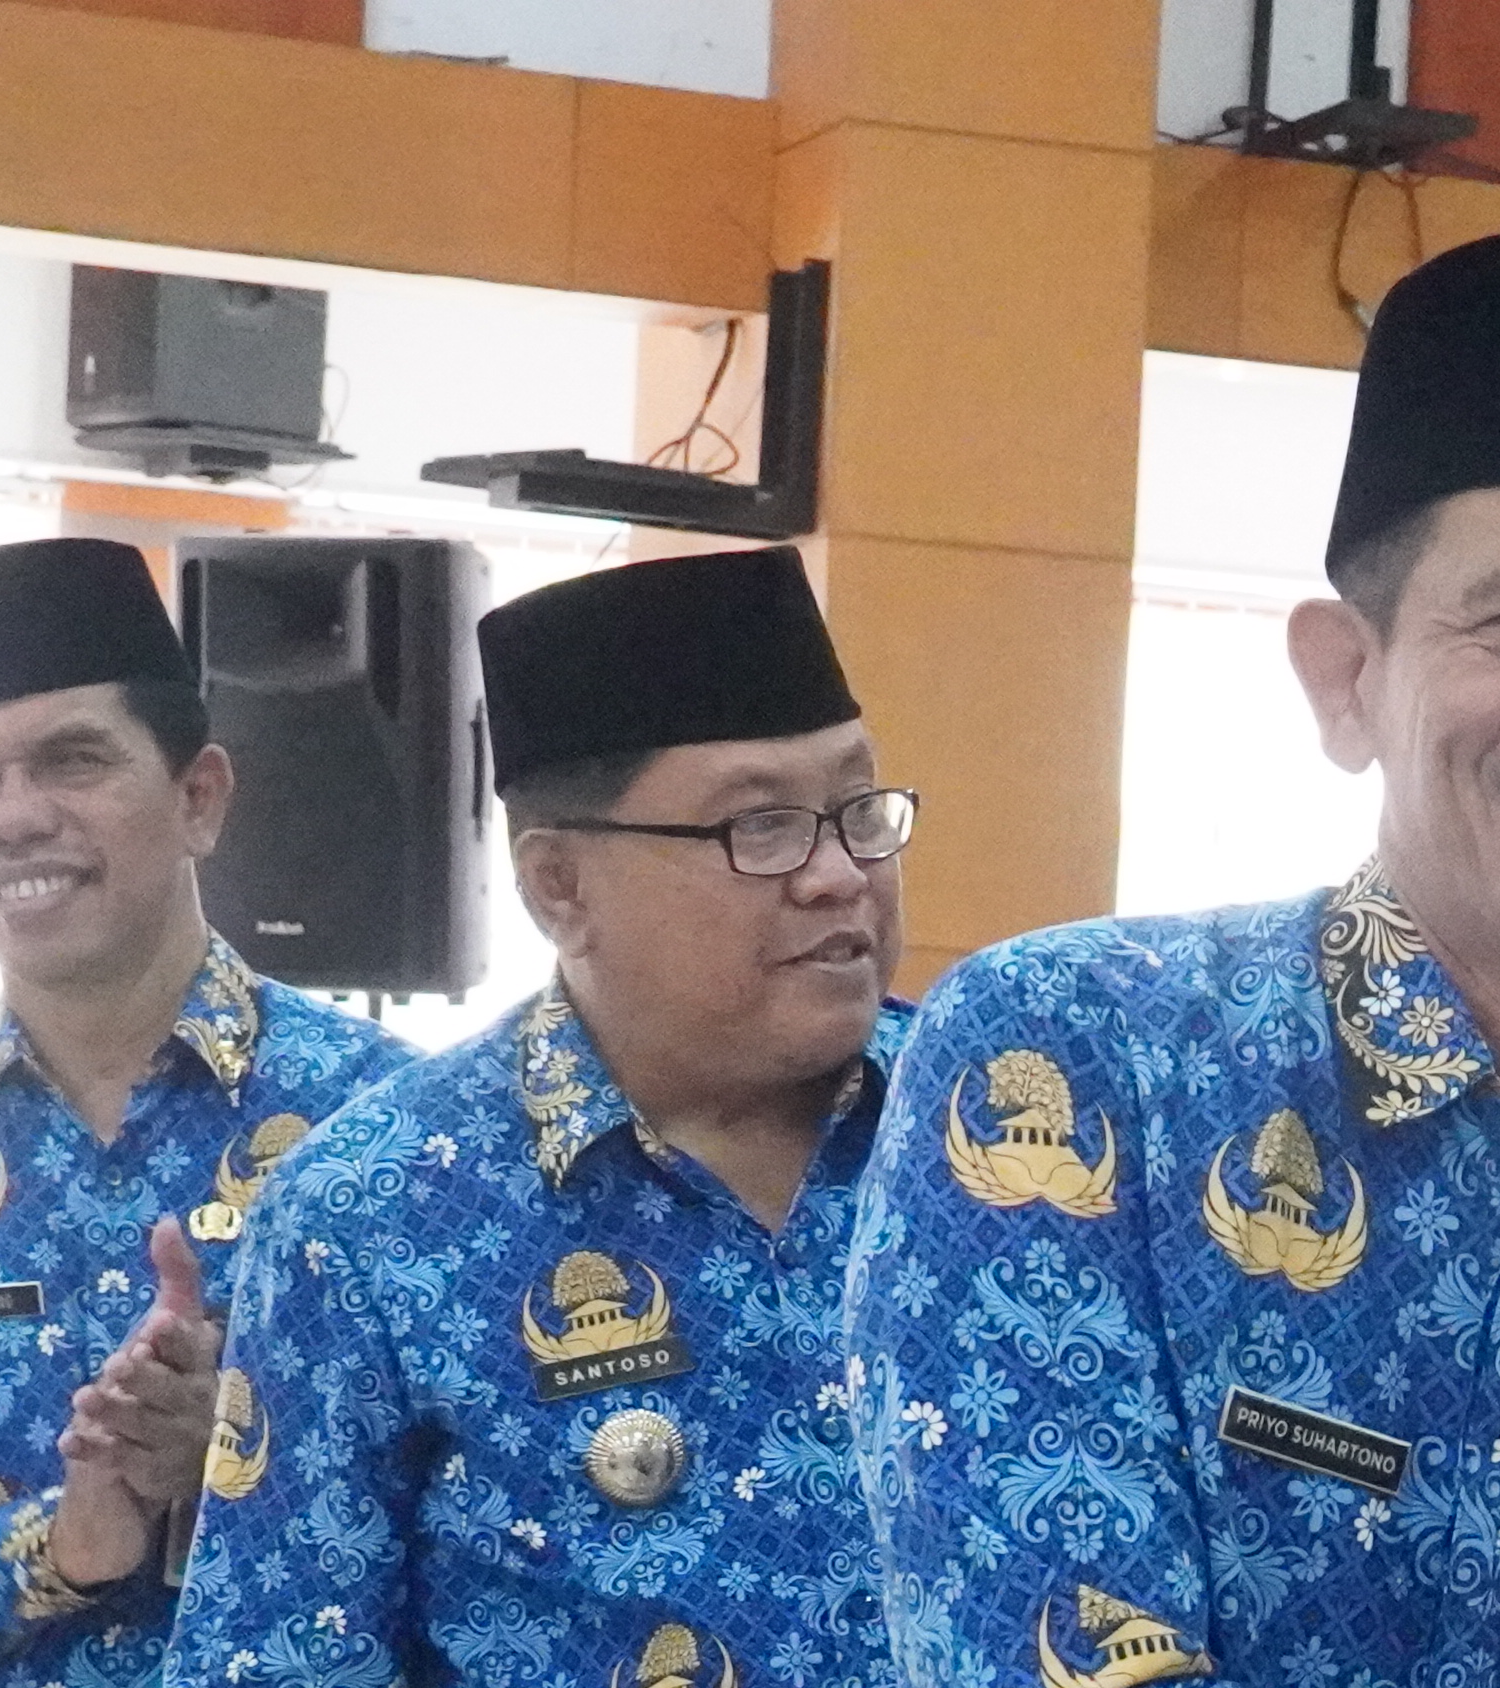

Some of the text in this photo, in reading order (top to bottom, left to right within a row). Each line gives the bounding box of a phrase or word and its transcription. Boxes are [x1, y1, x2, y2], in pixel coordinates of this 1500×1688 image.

[554, 1349, 671, 1387] SANTOSO
[1236, 1406, 1396, 1475] PRIYO SUHARTONO
